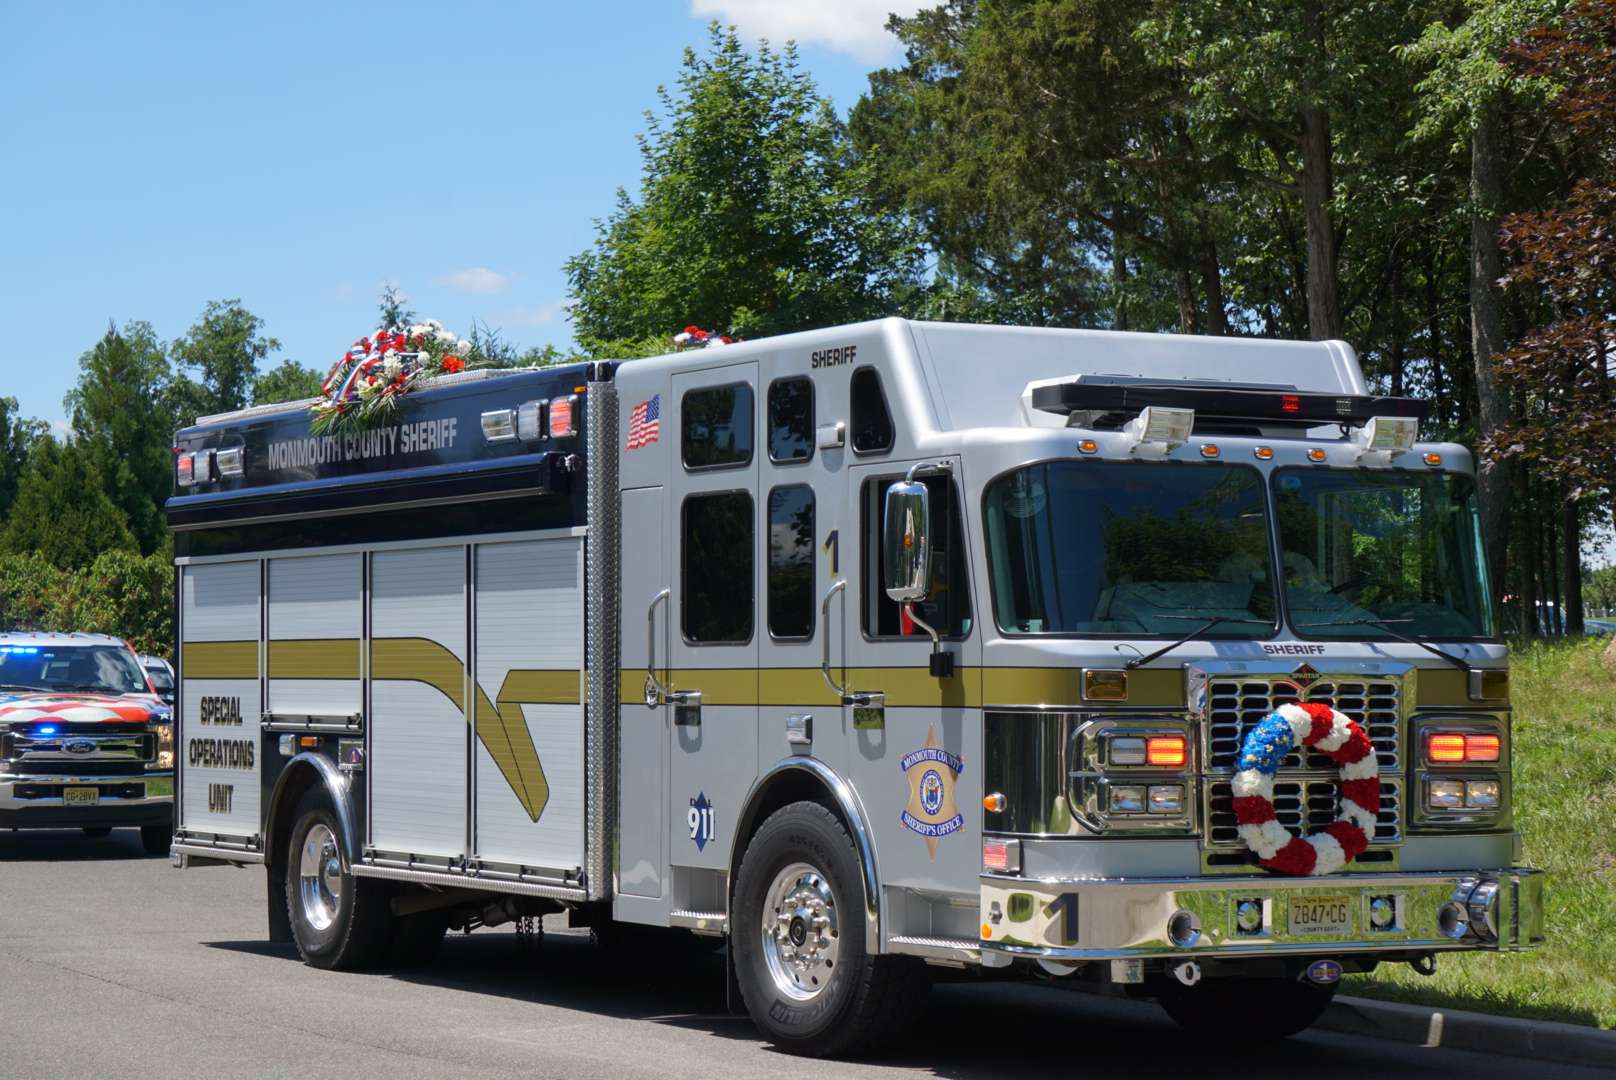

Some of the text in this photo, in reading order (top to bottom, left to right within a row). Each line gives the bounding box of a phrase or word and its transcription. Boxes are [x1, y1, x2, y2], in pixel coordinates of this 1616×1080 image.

[811, 345, 857, 369] SHERIFF
[268, 417, 457, 471] MONMOUTH COUNTY SHERIFF
[824, 530, 839, 576] 1
[1263, 644, 1325, 655] SHERIFF
[201, 696, 243, 726] SPECIAL
[190, 738, 255, 769] OPERATIONS
[904, 748, 960, 770] MONMOUTH COUNTY
[208, 783, 234, 814] UNIT
[688, 807, 716, 841] 911
[903, 812, 962, 836] SHERIFF'S OFFICE
[1042, 893, 1079, 947] 1
